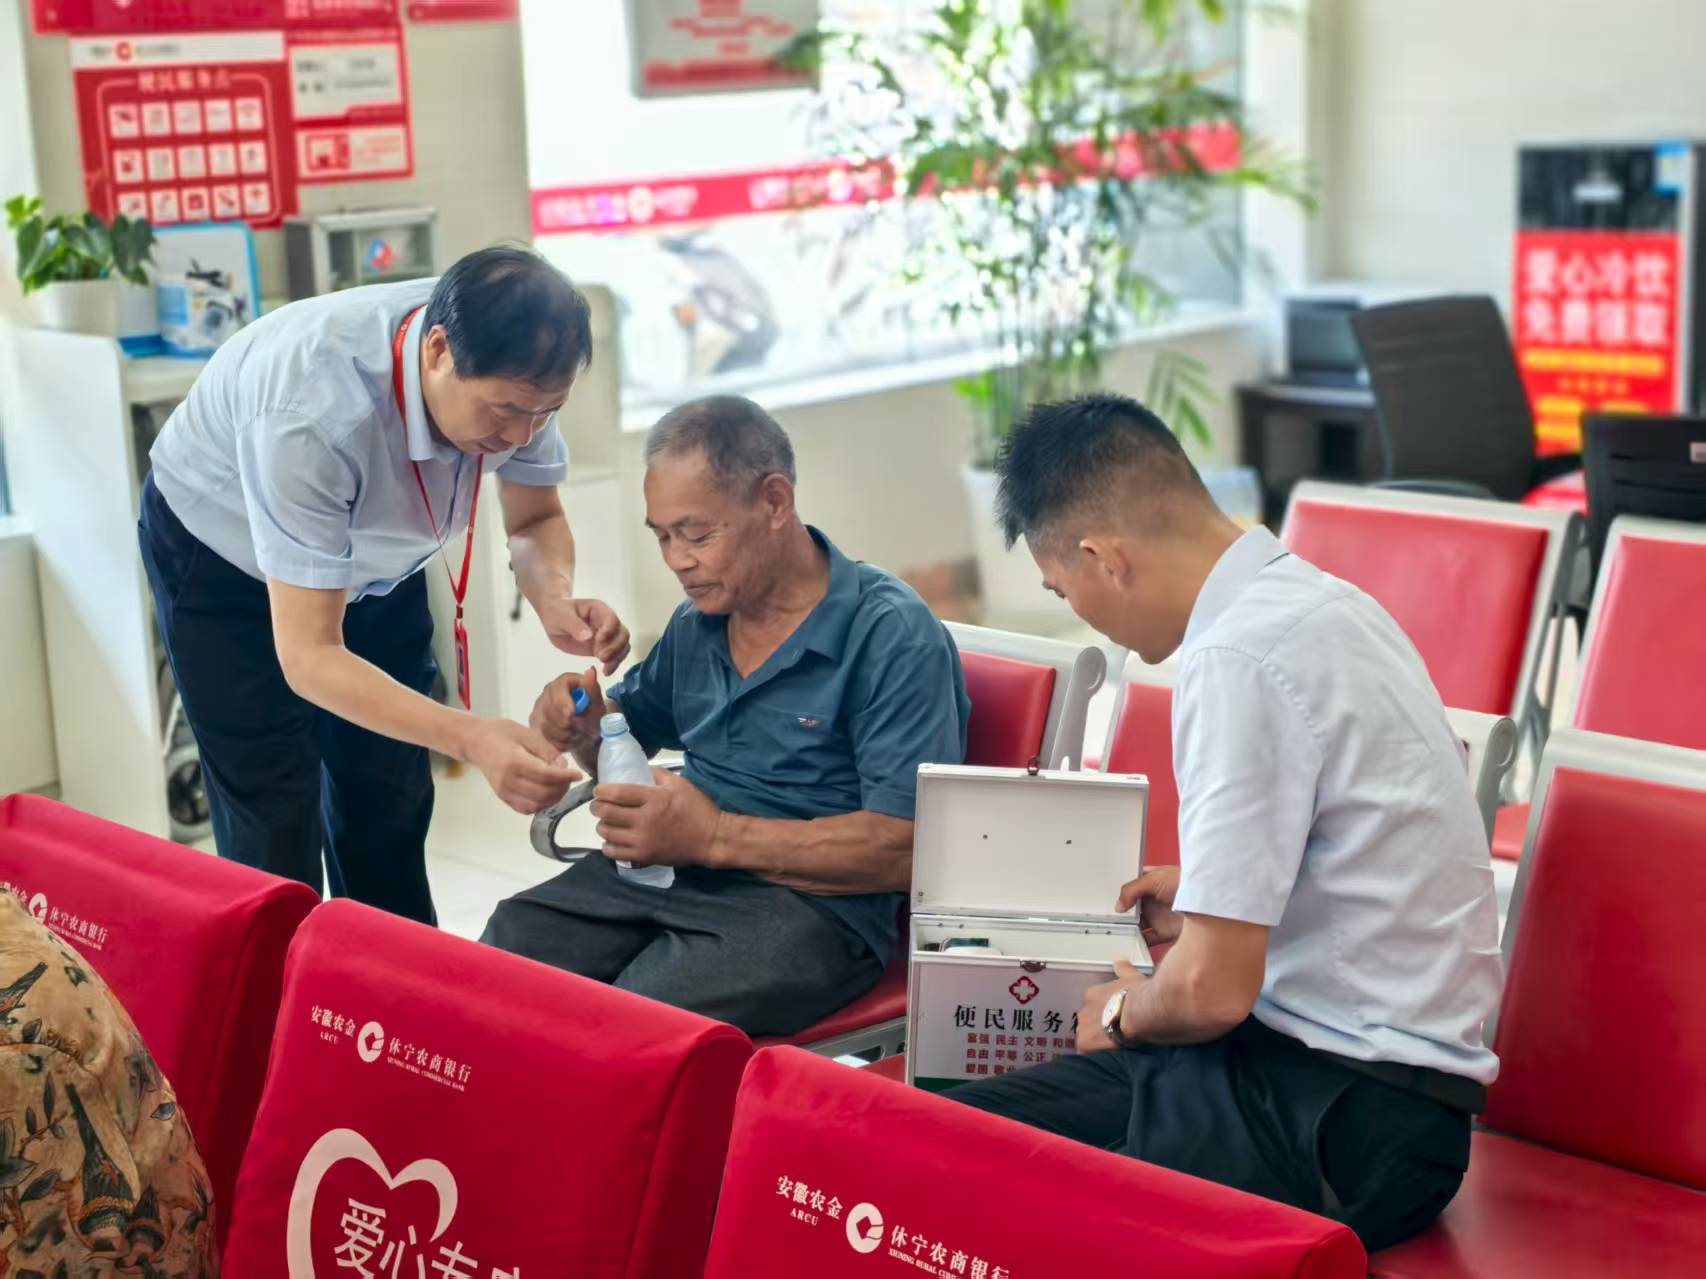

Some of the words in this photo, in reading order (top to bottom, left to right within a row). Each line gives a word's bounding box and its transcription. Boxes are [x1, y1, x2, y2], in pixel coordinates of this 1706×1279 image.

[1525, 249, 1669, 297] 爱心冷饮
[311, 1005, 356, 1038] 安徽农金
[967, 1048, 989, 1060] 自由
[995, 1049, 1017, 1061] 平等
[1024, 1051, 1046, 1062] 公正
[996, 1034, 1018, 1046] 民主
[1024, 1036, 1047, 1047] 文明
[388, 1037, 472, 1083] 休宁农商银行
[776, 1175, 843, 1220] 安徽农金
[790, 1208, 819, 1226] ARCU
